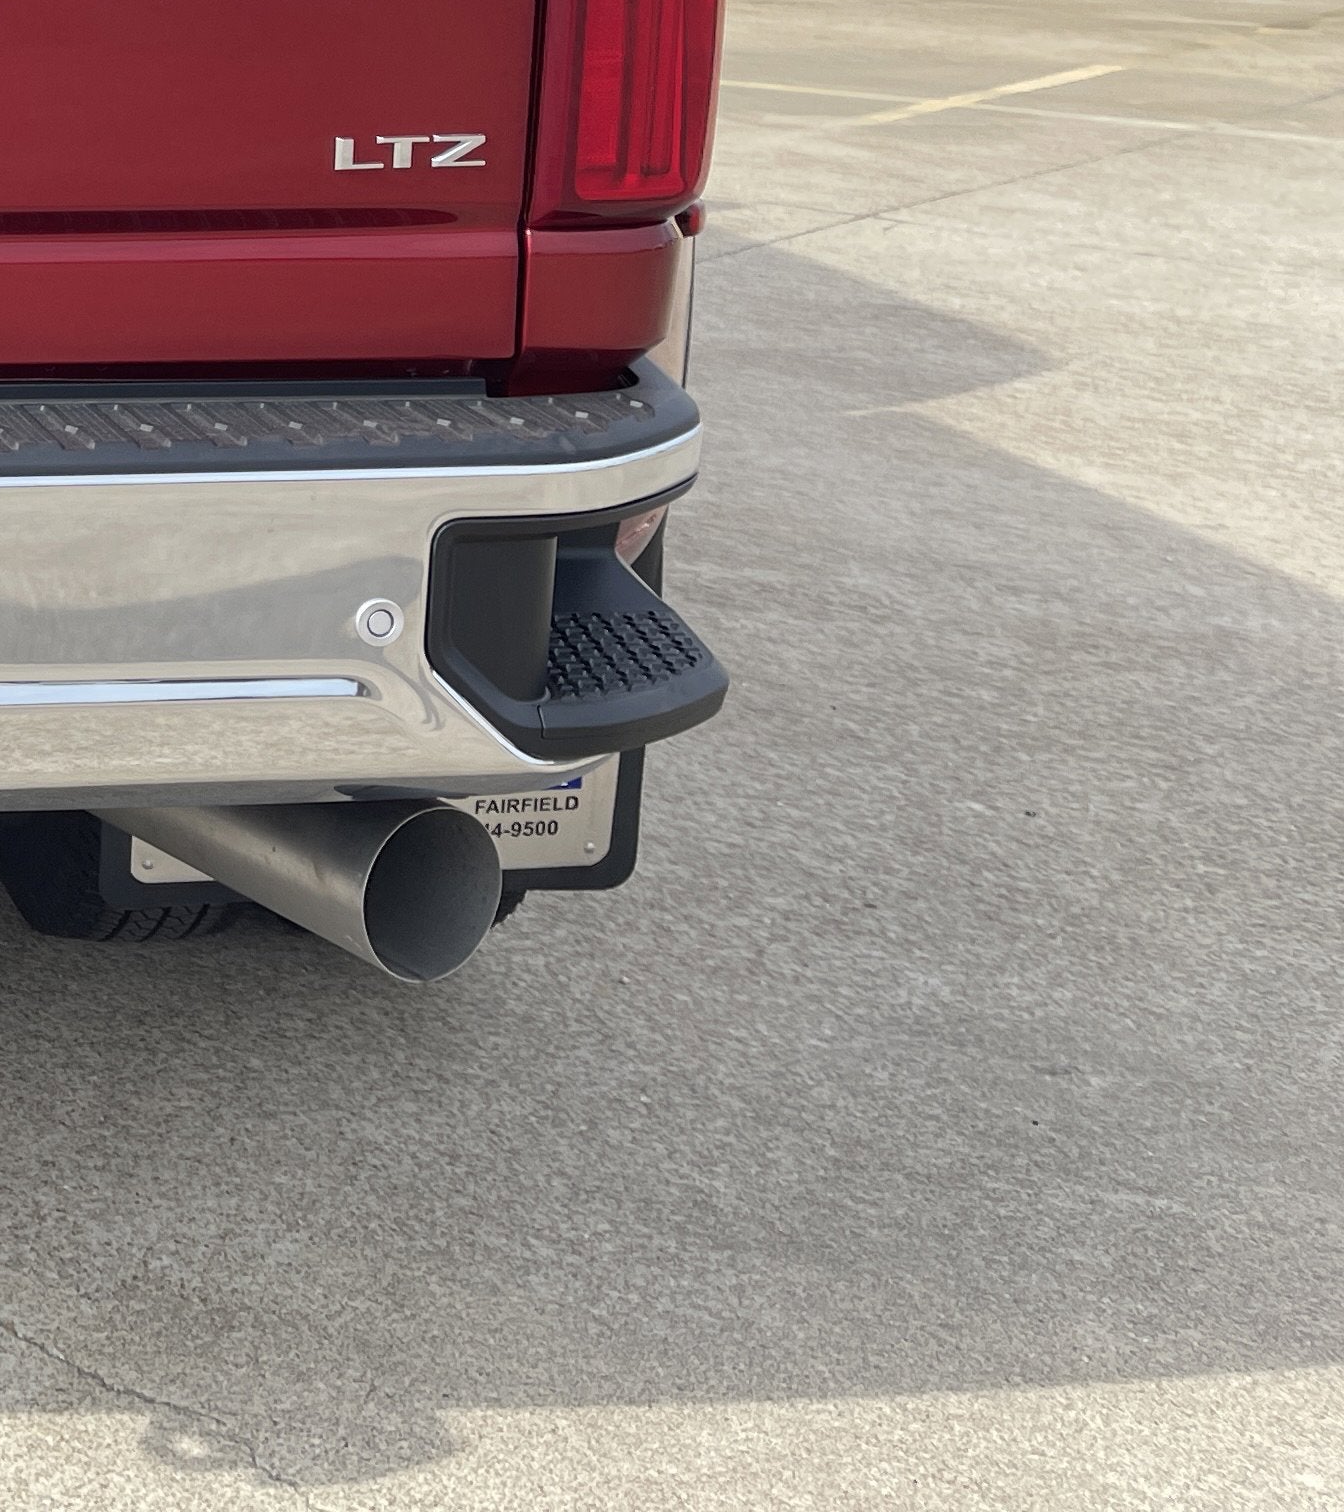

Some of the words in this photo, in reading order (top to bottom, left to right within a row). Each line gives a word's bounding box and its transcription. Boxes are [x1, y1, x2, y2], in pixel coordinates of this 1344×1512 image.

[334, 134, 487, 171] LTZ
[475, 796, 579, 815] FAIRFIELD
[485, 820, 559, 838] 4-9500
